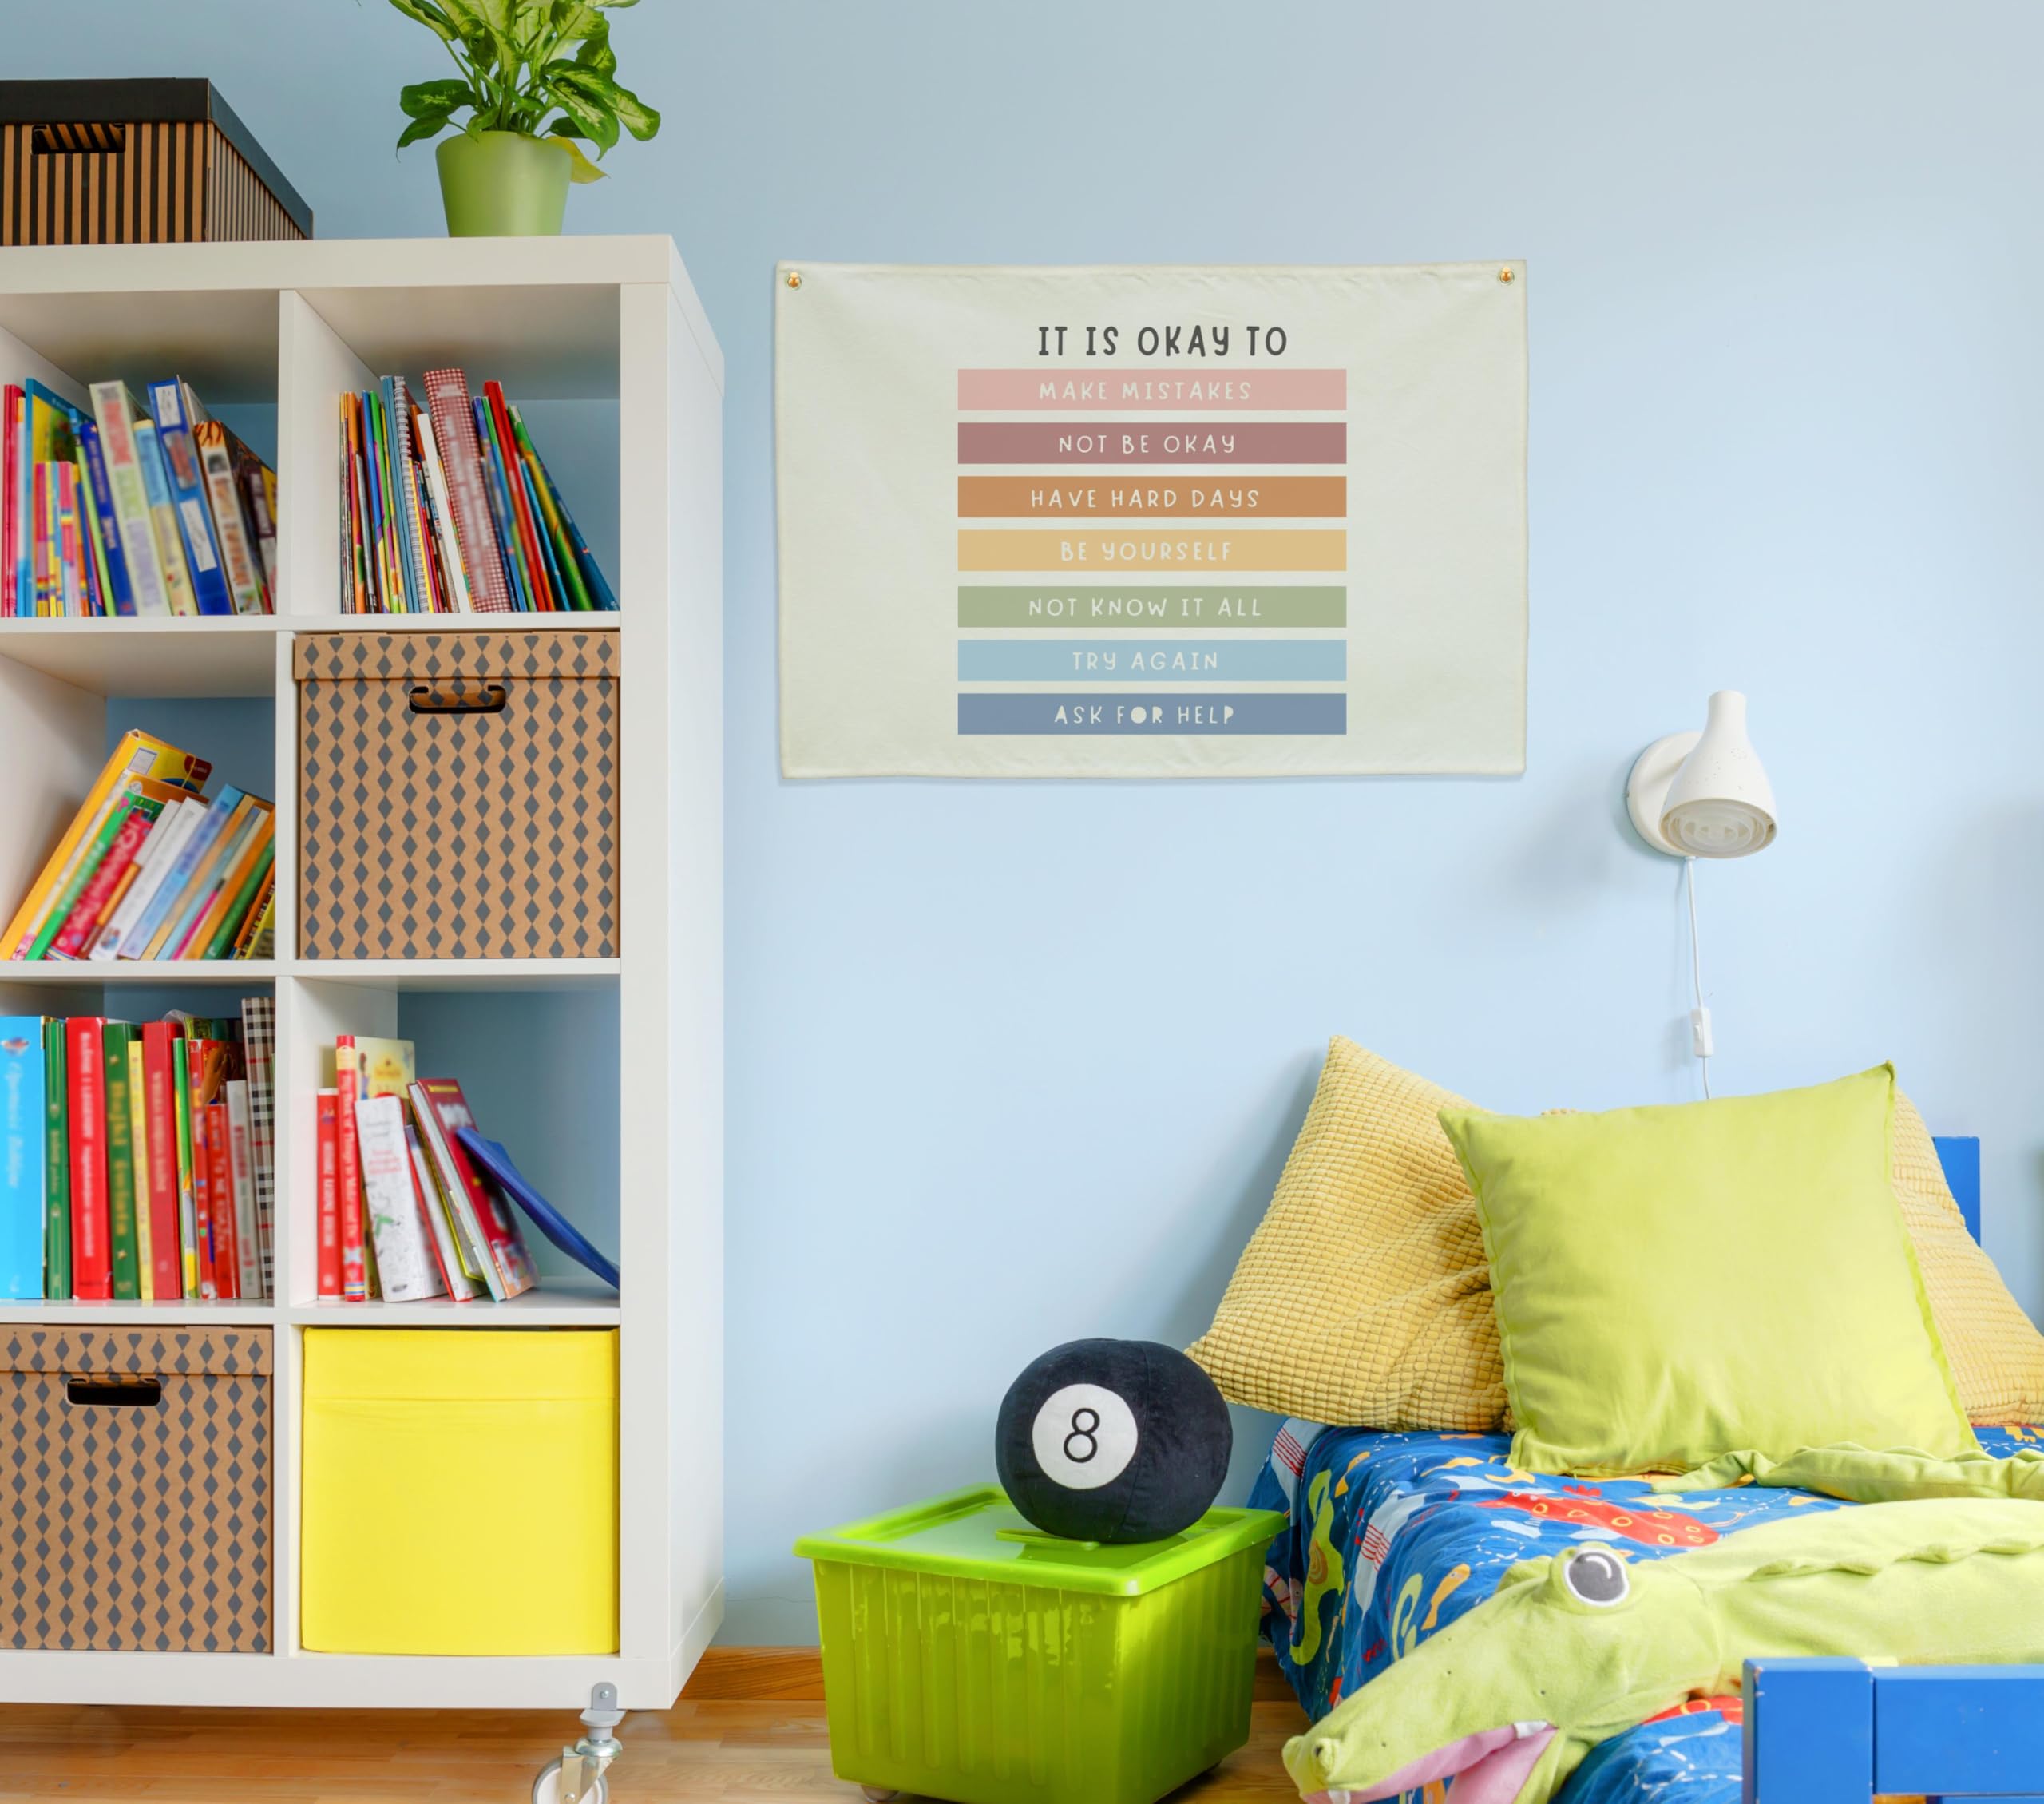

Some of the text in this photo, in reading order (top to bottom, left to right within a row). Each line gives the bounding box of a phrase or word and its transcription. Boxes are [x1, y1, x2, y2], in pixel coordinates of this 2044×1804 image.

[1038, 324, 1287, 358] IT IS OKAY TO
[1039, 381, 1251, 401] MAKE MISTAKES
[1059, 434, 1234, 454] NOT BE OKAY
[1031, 488, 1259, 509] HAVE HARD DAYS
[1060, 541, 1231, 562] BE YOURSELF
[1028, 597, 1262, 617] NOT KNOW IT ALL
[1072, 651, 1218, 672] TRY AGAIN
[1054, 704, 1234, 725] ASK FOR HELP
[1063, 1407, 1100, 1464] 8
